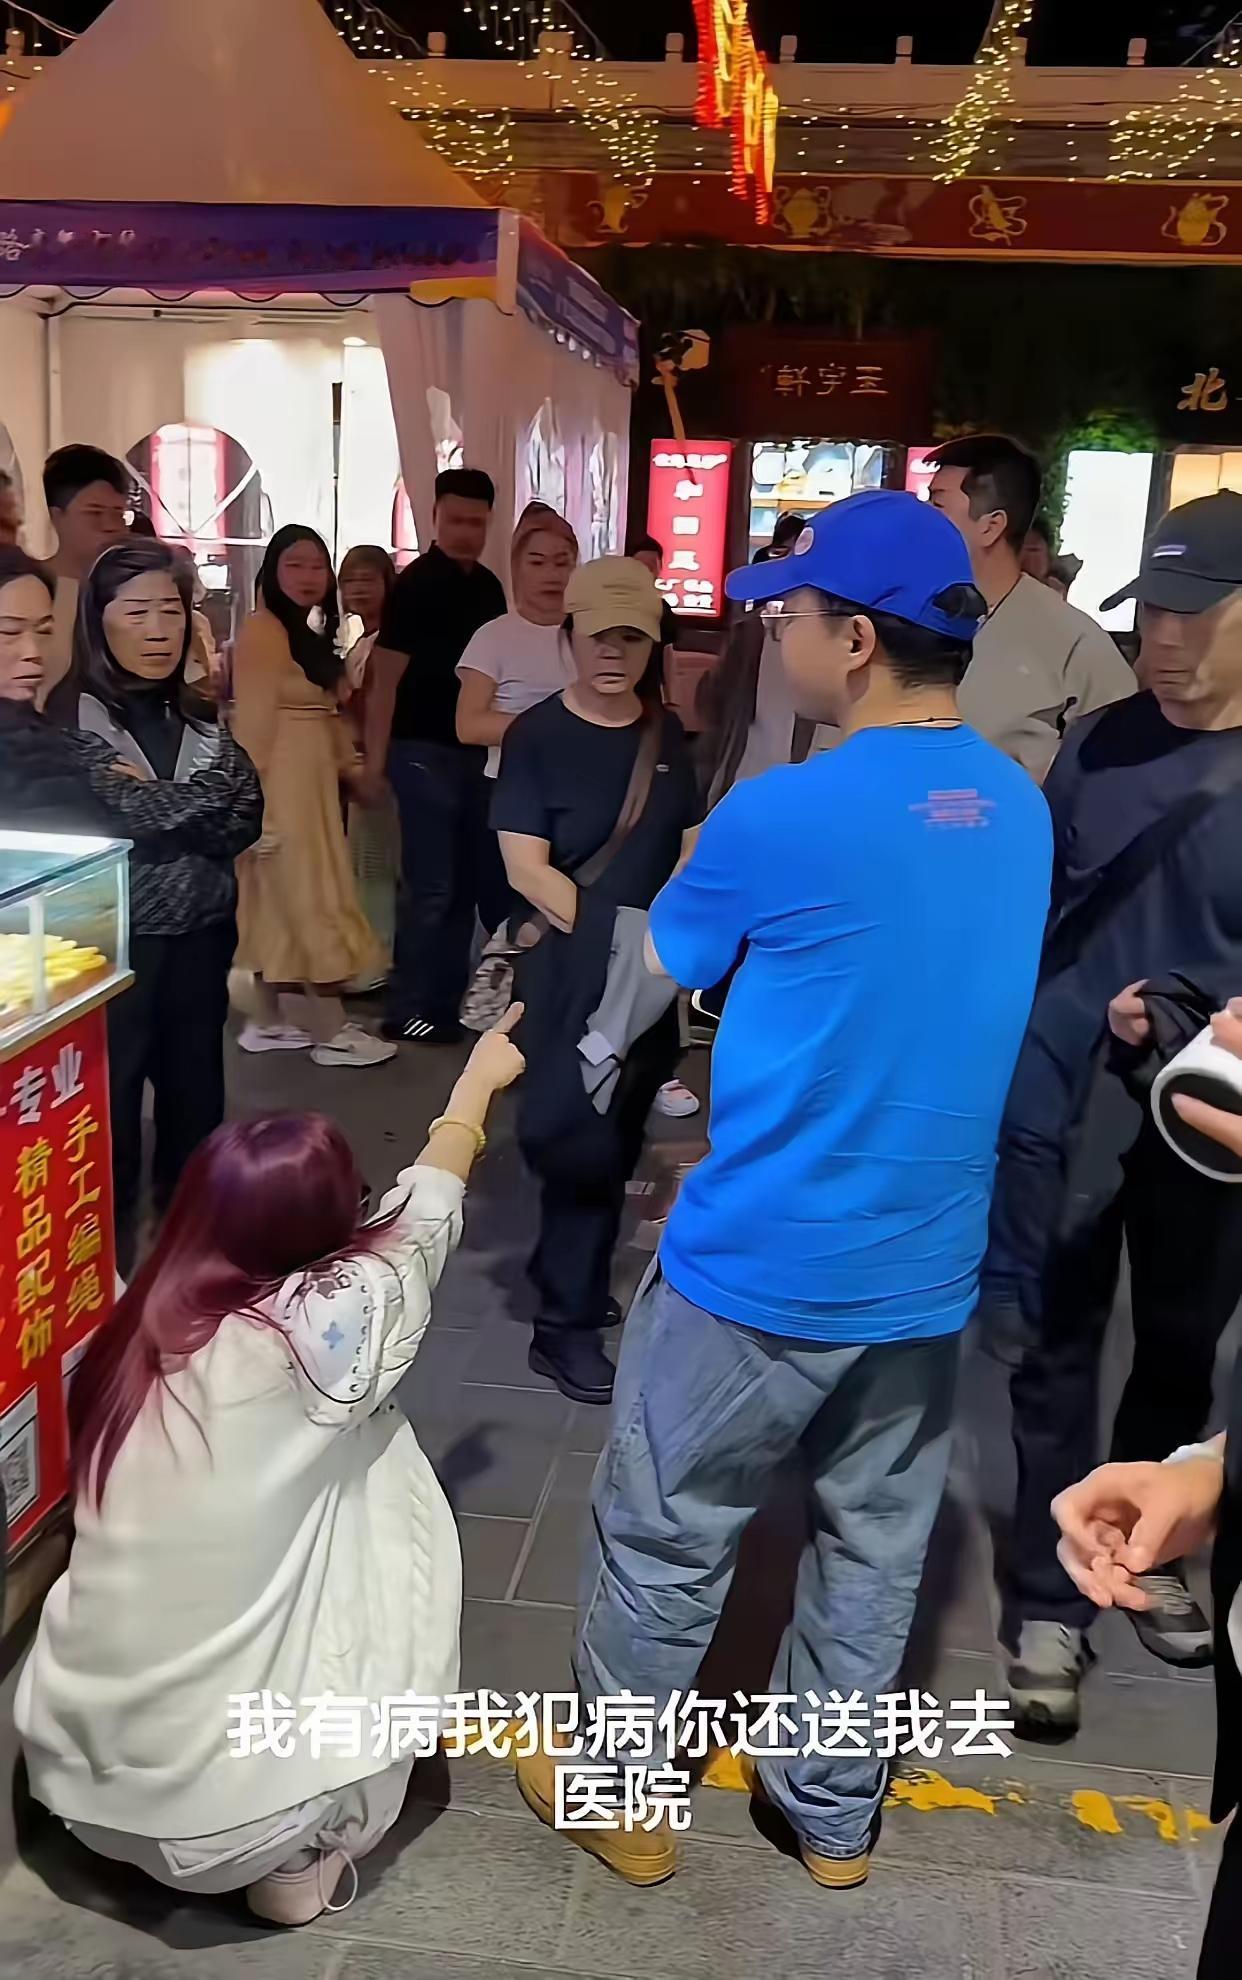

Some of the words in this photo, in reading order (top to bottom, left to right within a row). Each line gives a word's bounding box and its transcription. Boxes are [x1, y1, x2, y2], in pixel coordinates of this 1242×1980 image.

[1176, 366, 1242, 412] 北
[0, 1041, 85, 1126] 专业
[13, 1135, 56, 1371] 精品配饰
[62, 1103, 105, 1329] 手工编绳
